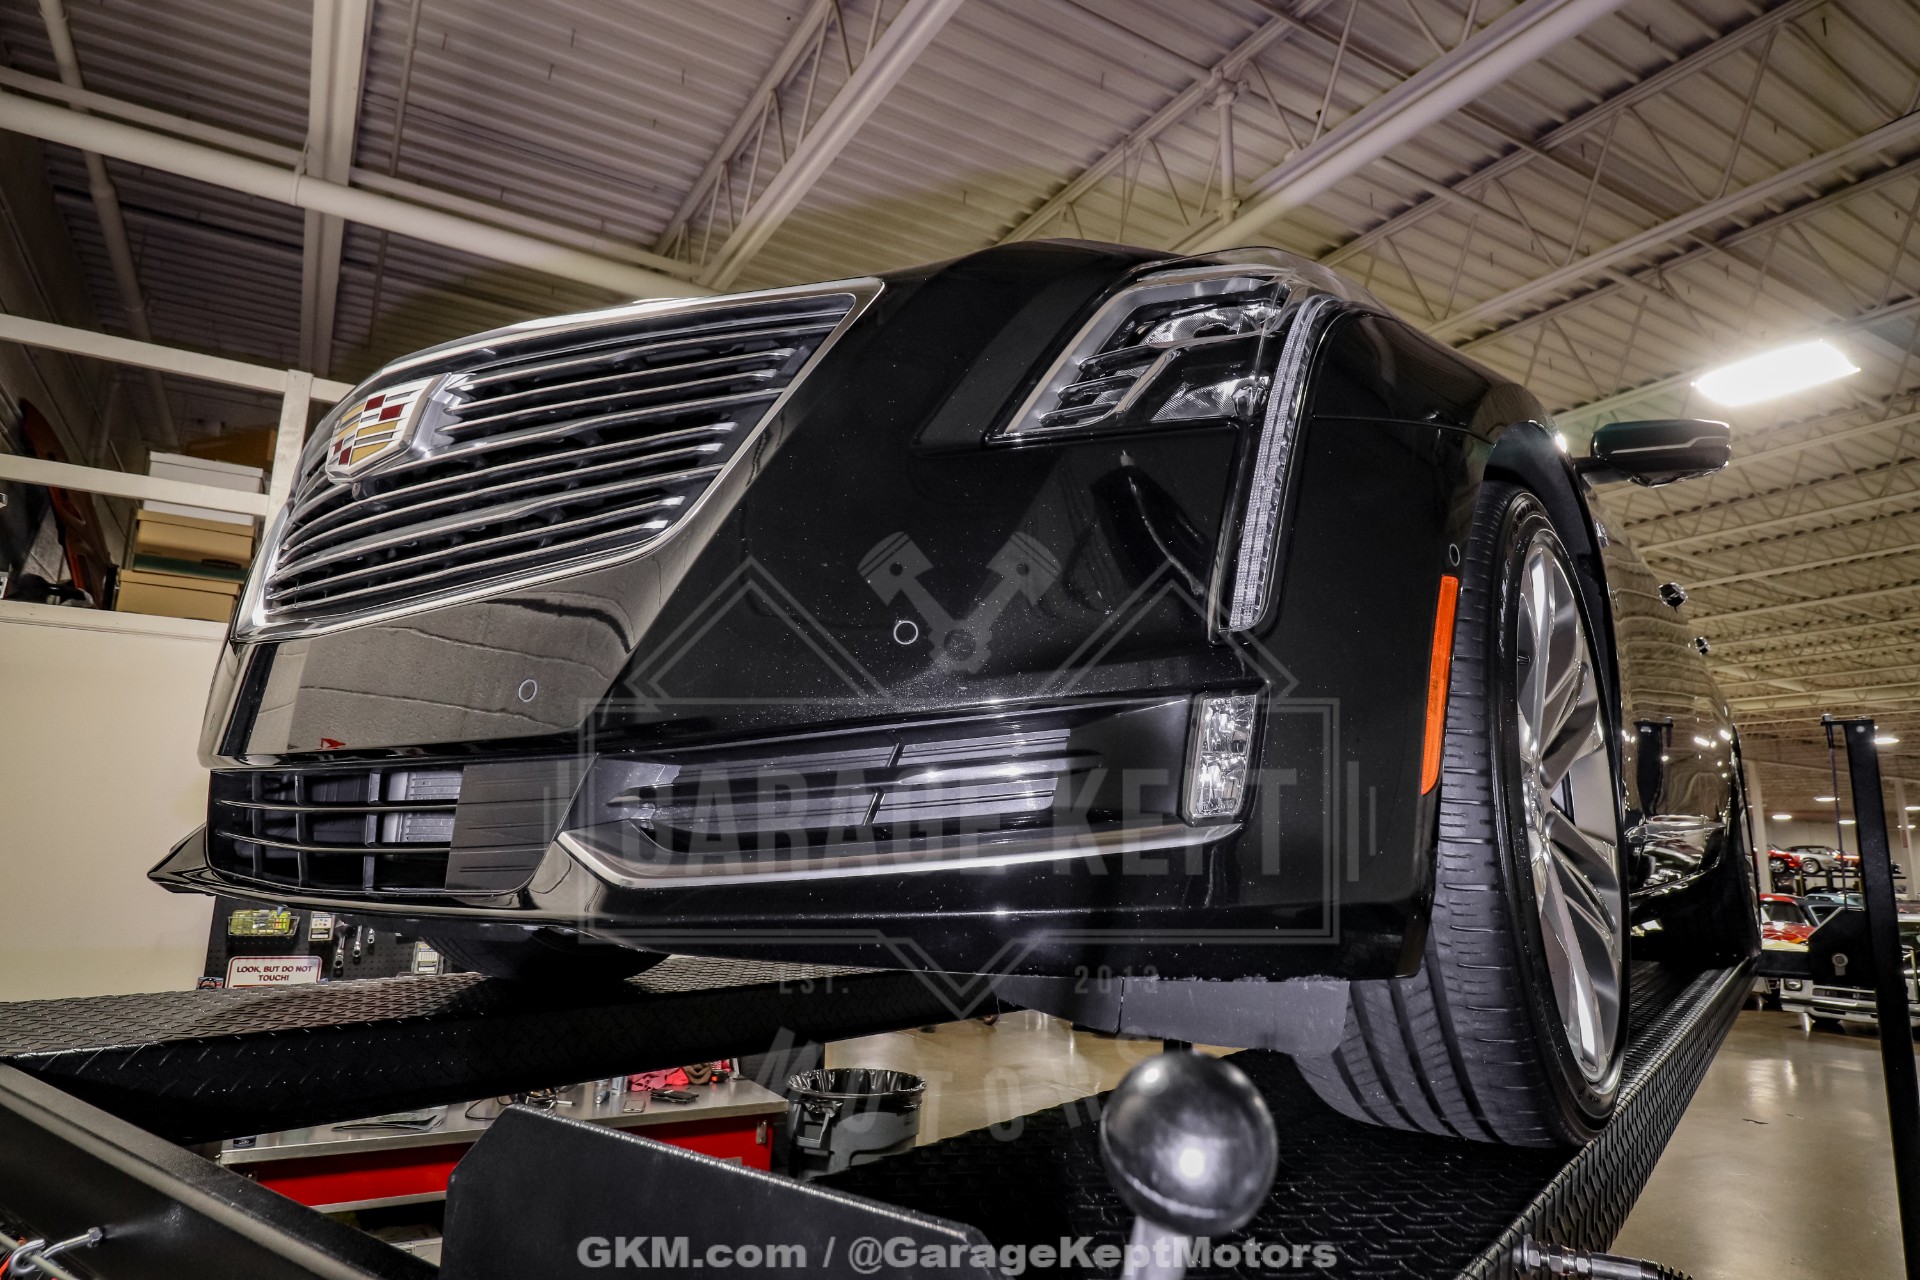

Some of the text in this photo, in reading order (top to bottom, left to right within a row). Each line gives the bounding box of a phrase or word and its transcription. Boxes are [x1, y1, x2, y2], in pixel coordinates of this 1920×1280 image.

[236, 965, 313, 973] LOOK, BUT DO NOT
[258, 974, 290, 982] TOUCH!
